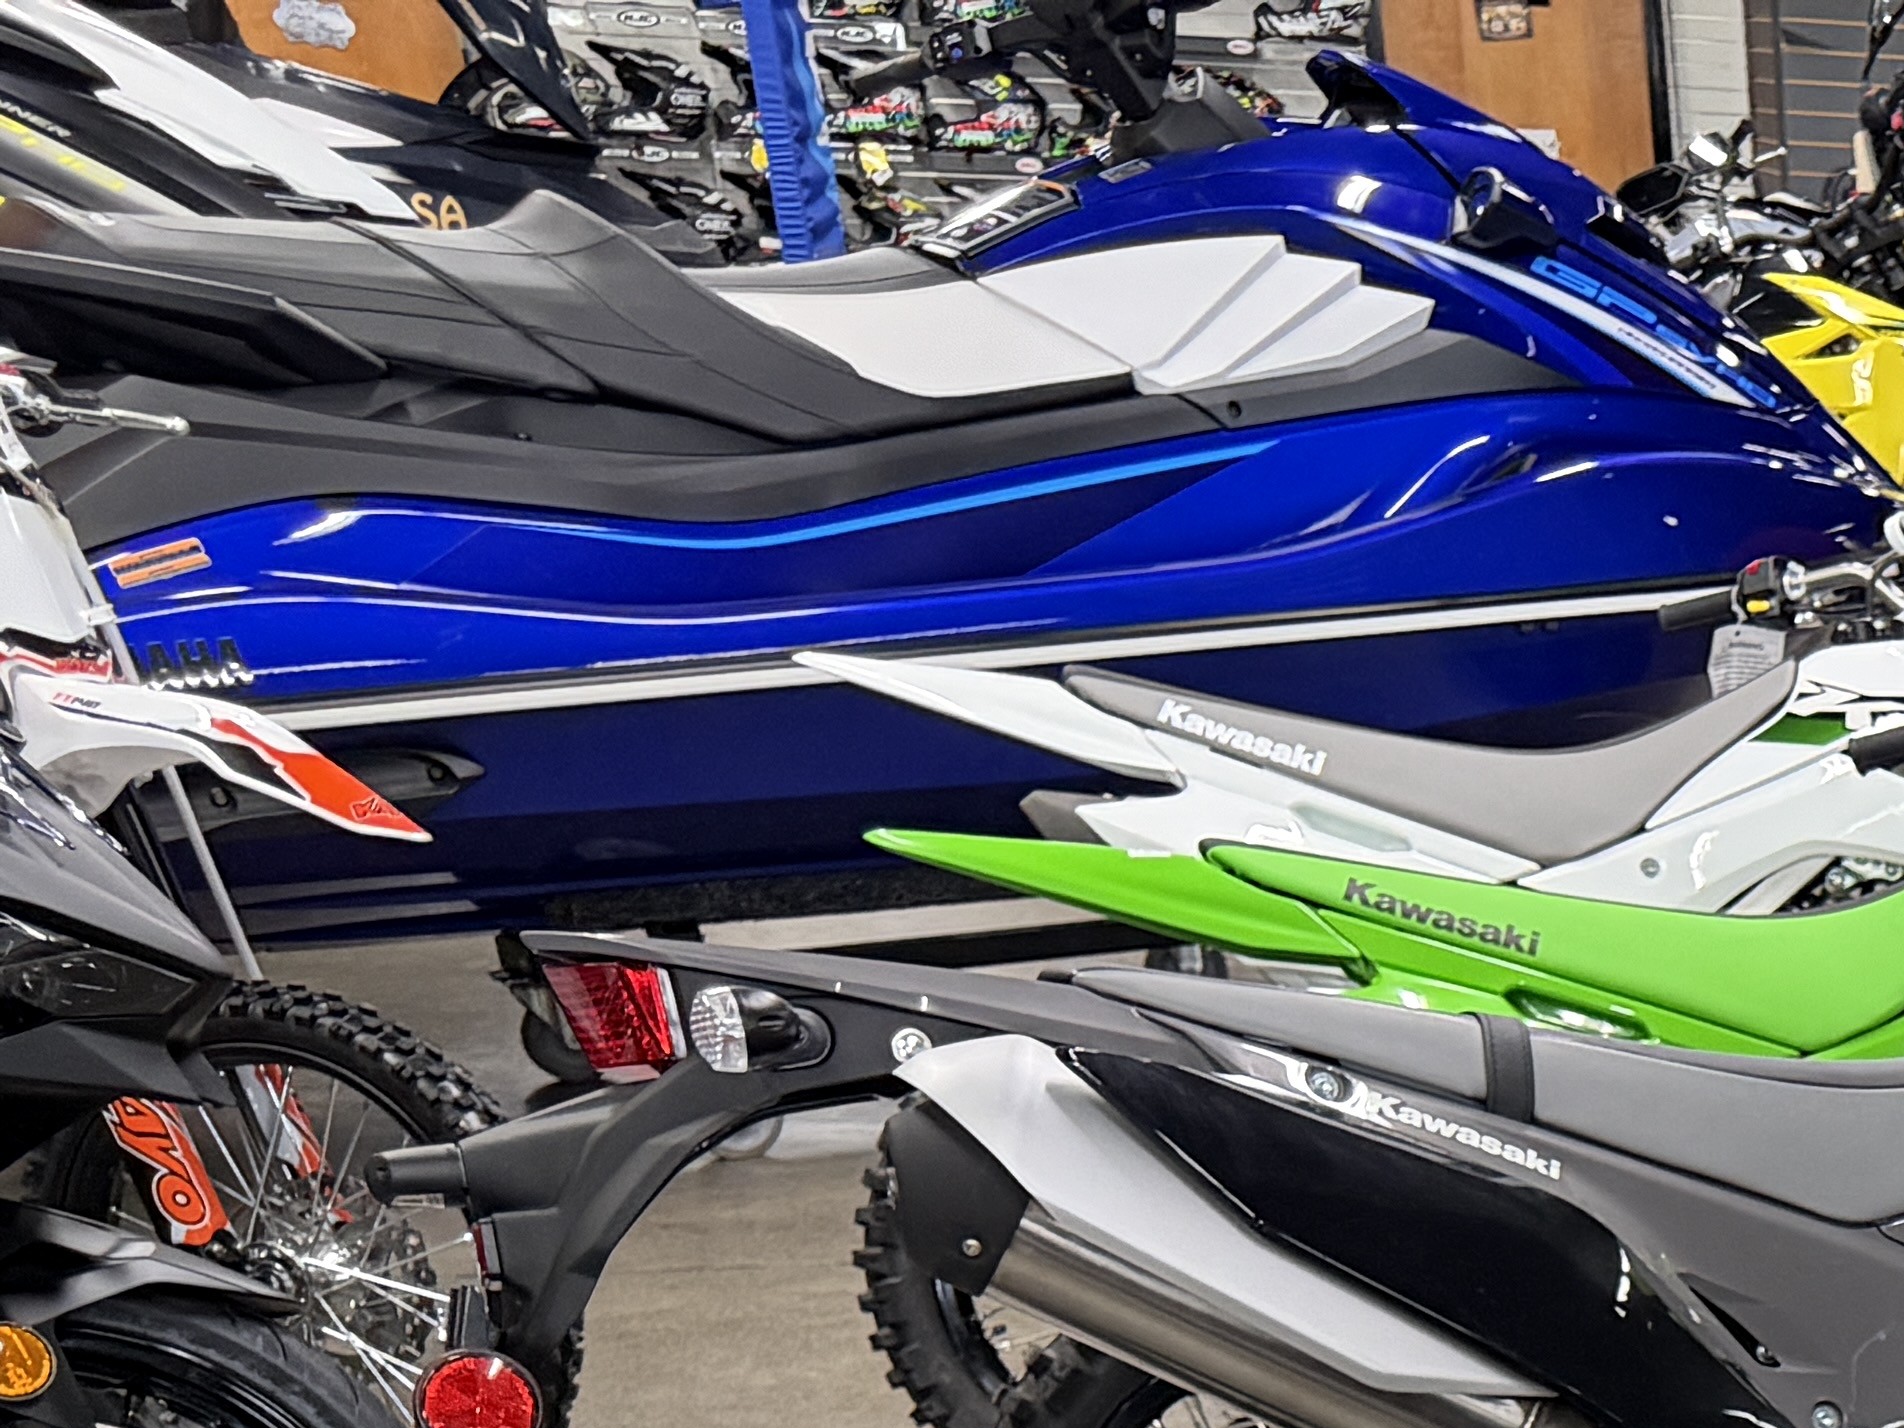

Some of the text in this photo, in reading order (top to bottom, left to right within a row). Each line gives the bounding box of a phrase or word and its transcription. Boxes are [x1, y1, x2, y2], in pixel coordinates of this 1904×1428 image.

[1156, 698, 1328, 777] Kawasaki
[1343, 878, 1543, 958] Kawasaki
[1367, 1091, 1562, 1181] Kawasaki
